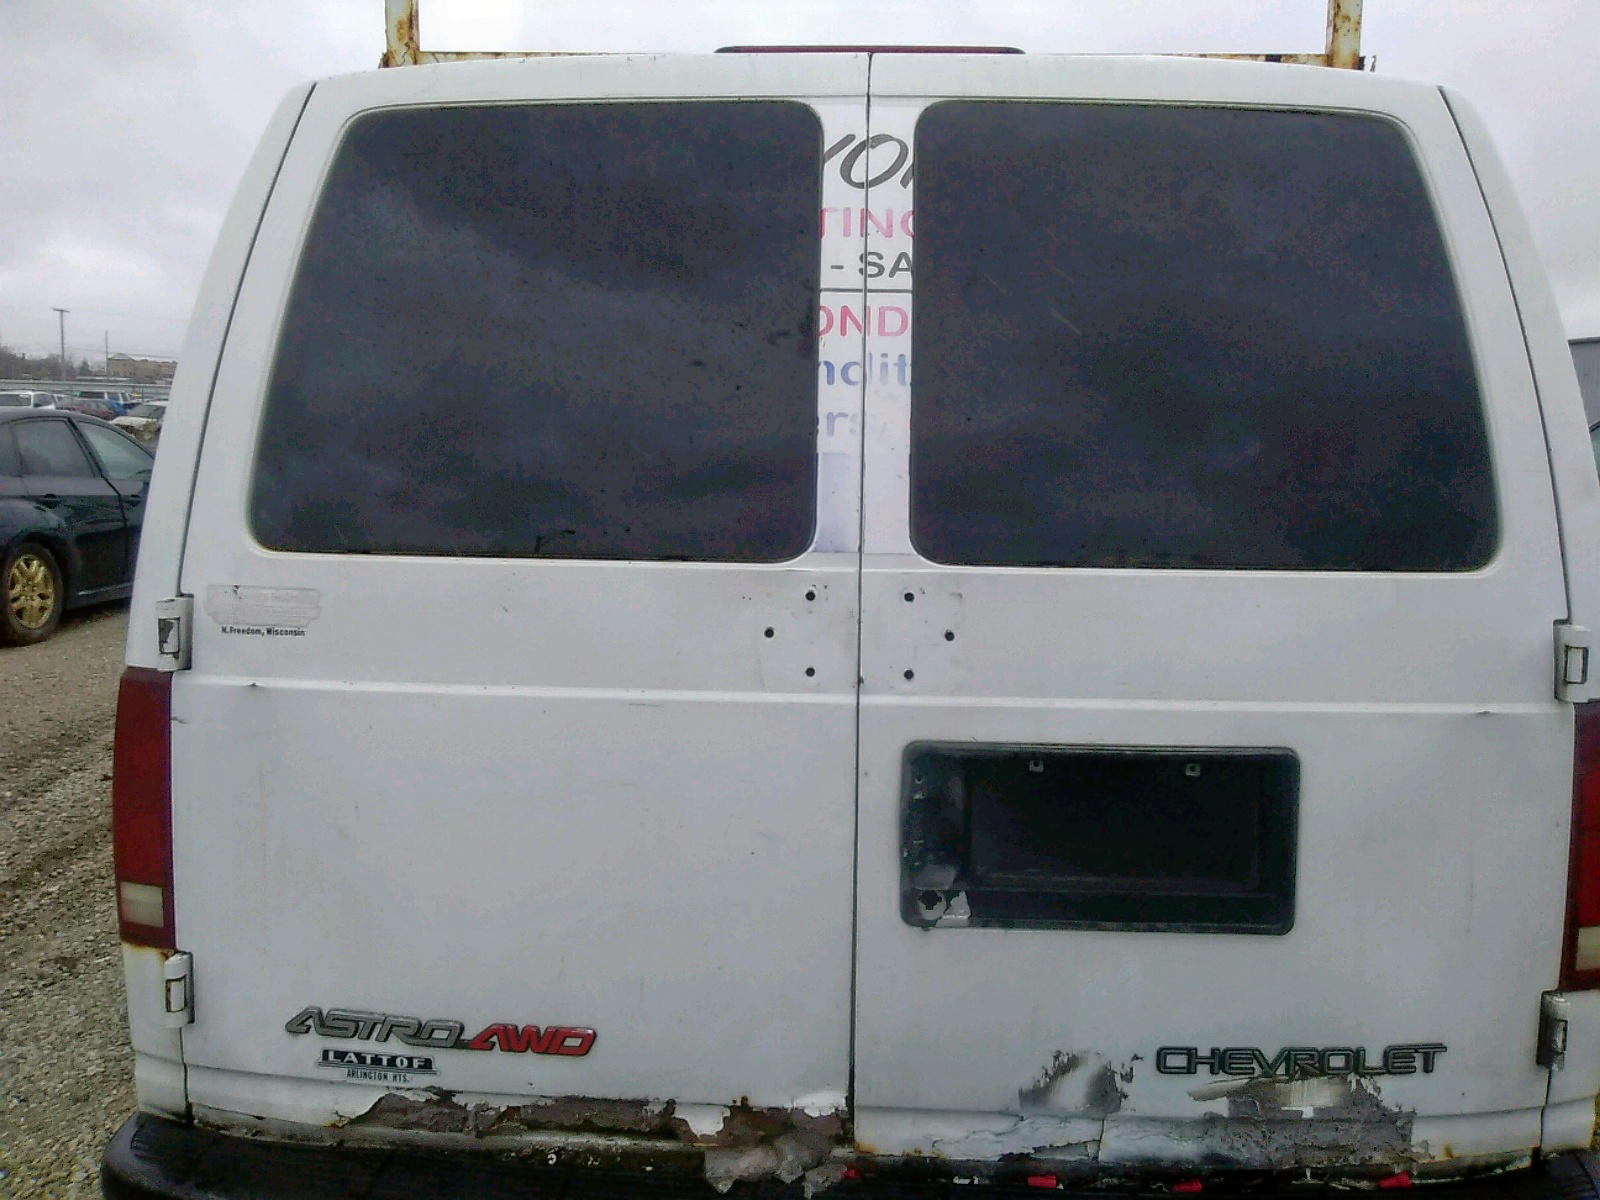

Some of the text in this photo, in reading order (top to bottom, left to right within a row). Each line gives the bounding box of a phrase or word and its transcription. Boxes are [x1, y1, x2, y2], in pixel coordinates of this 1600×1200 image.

[266, 626, 306, 637] Wisconsin
[285, 1006, 597, 1056] ASTRO AWD
[327, 1050, 427, 1070] LATTOF
[1156, 1043, 1447, 1078] CHEVROLET
[346, 1068, 389, 1081] ARLINGTON
